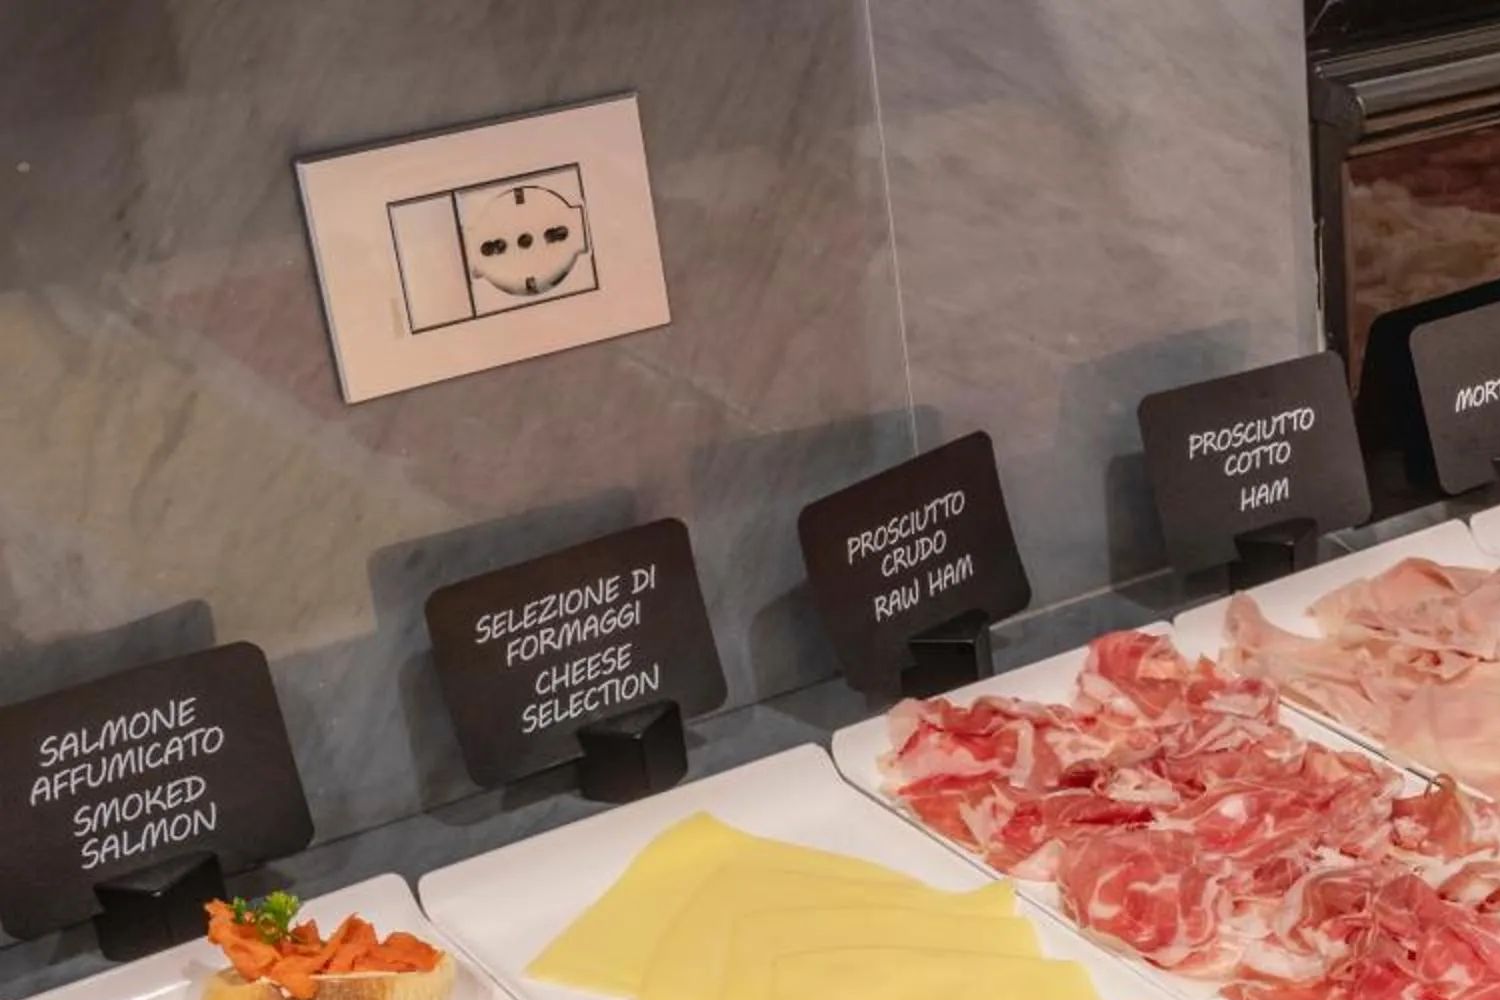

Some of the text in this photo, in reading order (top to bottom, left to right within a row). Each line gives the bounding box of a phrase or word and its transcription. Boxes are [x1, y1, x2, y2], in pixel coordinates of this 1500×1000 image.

[1188, 406, 1315, 460] PROSCIUTTO
[1224, 440, 1292, 477] COTTO
[847, 490, 965, 565] PROSCIUTTO
[1240, 477, 1289, 512] HAM
[880, 529, 947, 577] CRUDO
[475, 563, 656, 644] SELEZIONE DI
[874, 553, 974, 622] RAW HAM
[506, 600, 641, 667] FORMAGGI
[522, 663, 659, 733] SELECTION
[535, 642, 631, 695] CHEESE
[30, 725, 225, 806] AFFUMICATO
[39, 697, 195, 767] SALMONE
[73, 775, 206, 837] SMOKED
[81, 801, 217, 870] SALMON
